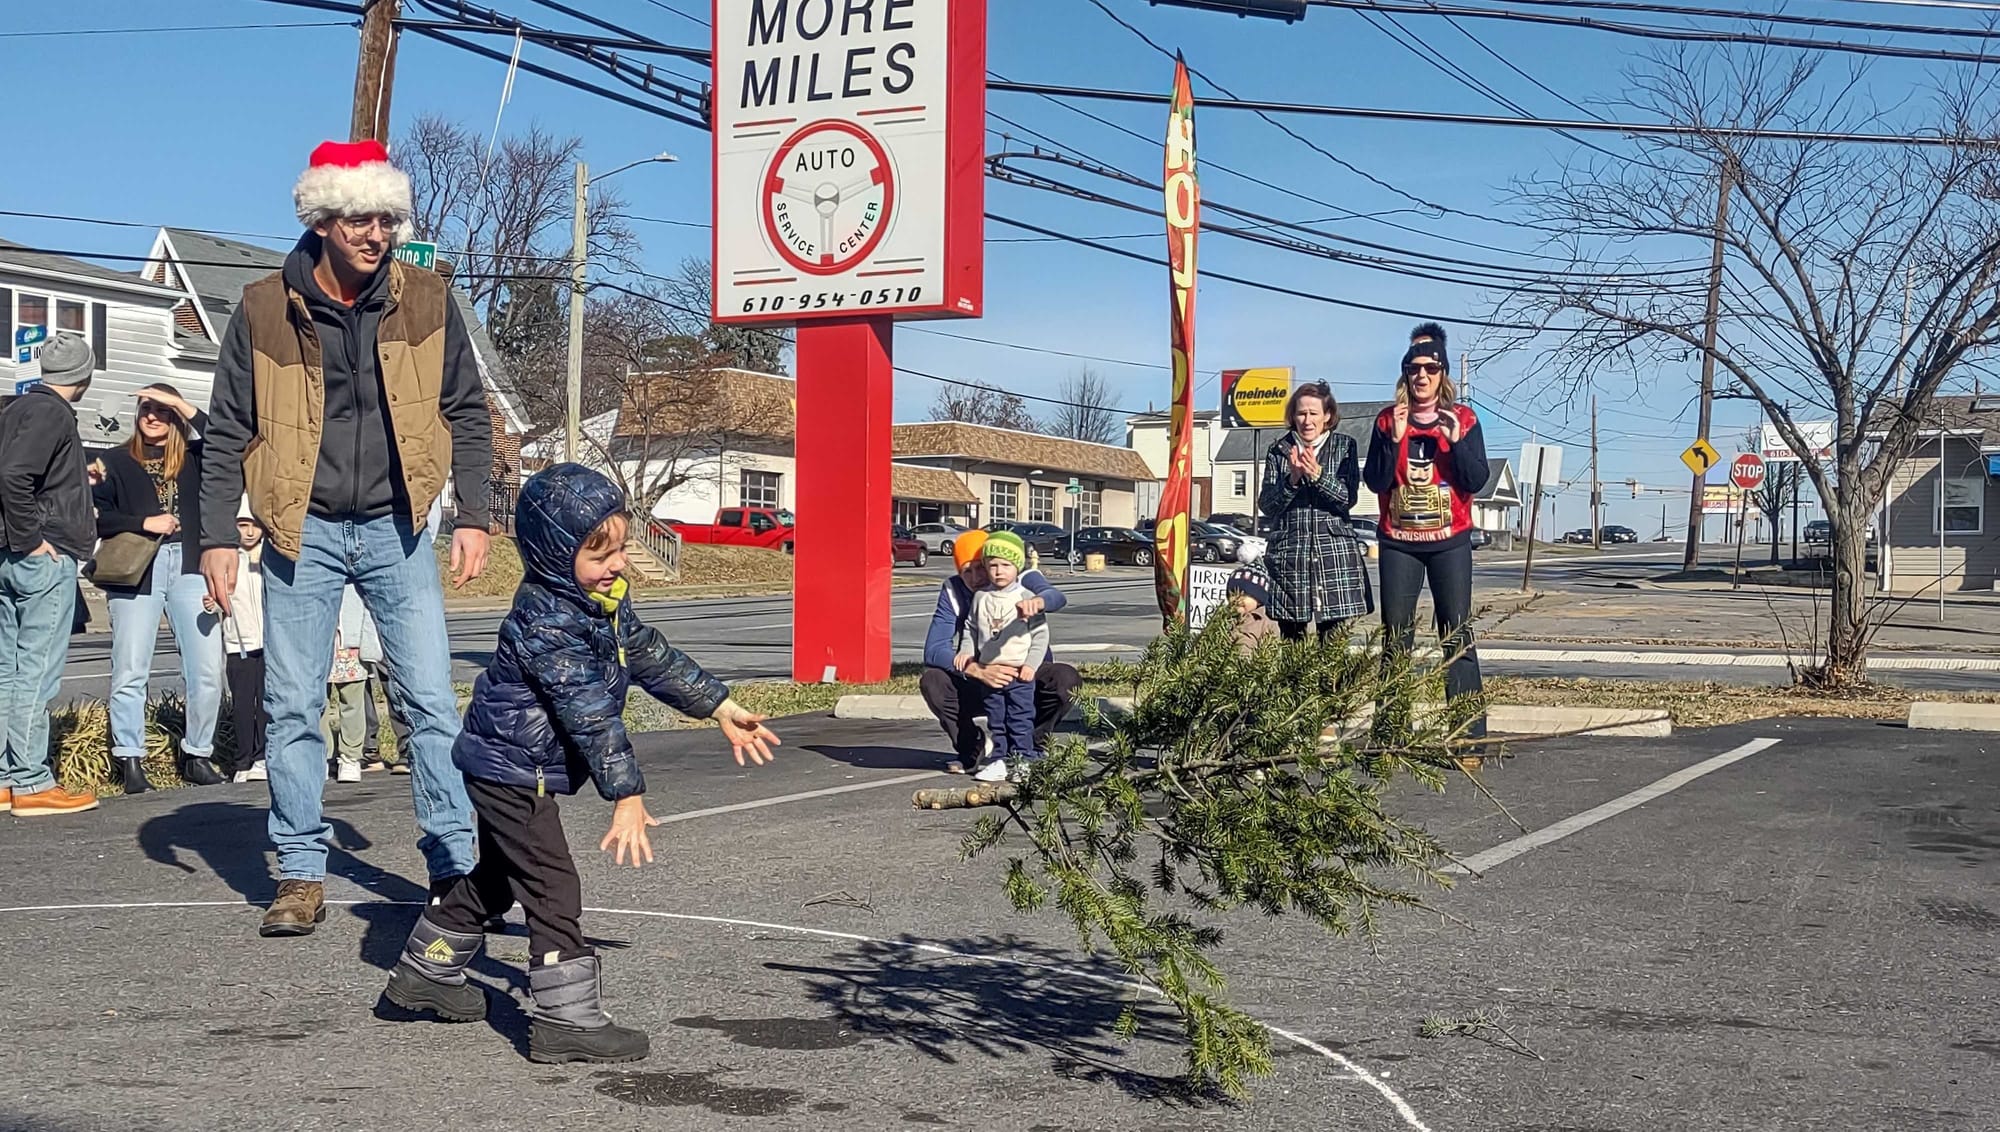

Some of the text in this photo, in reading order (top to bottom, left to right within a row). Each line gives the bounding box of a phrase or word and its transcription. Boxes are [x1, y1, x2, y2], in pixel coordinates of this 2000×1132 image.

[747, 0, 914, 46] MORE
[740, 42, 916, 109] MILES
[795, 147, 855, 173] AUTO
[776, 201, 879, 256] SERVICE CENTER
[423, 250, 433, 267] St
[742, 286, 922, 313] 610-954-0510
[1235, 387, 1287, 400] meineke
[1734, 463, 1763, 478] STOP
[1193, 586, 1227, 601] TREE
